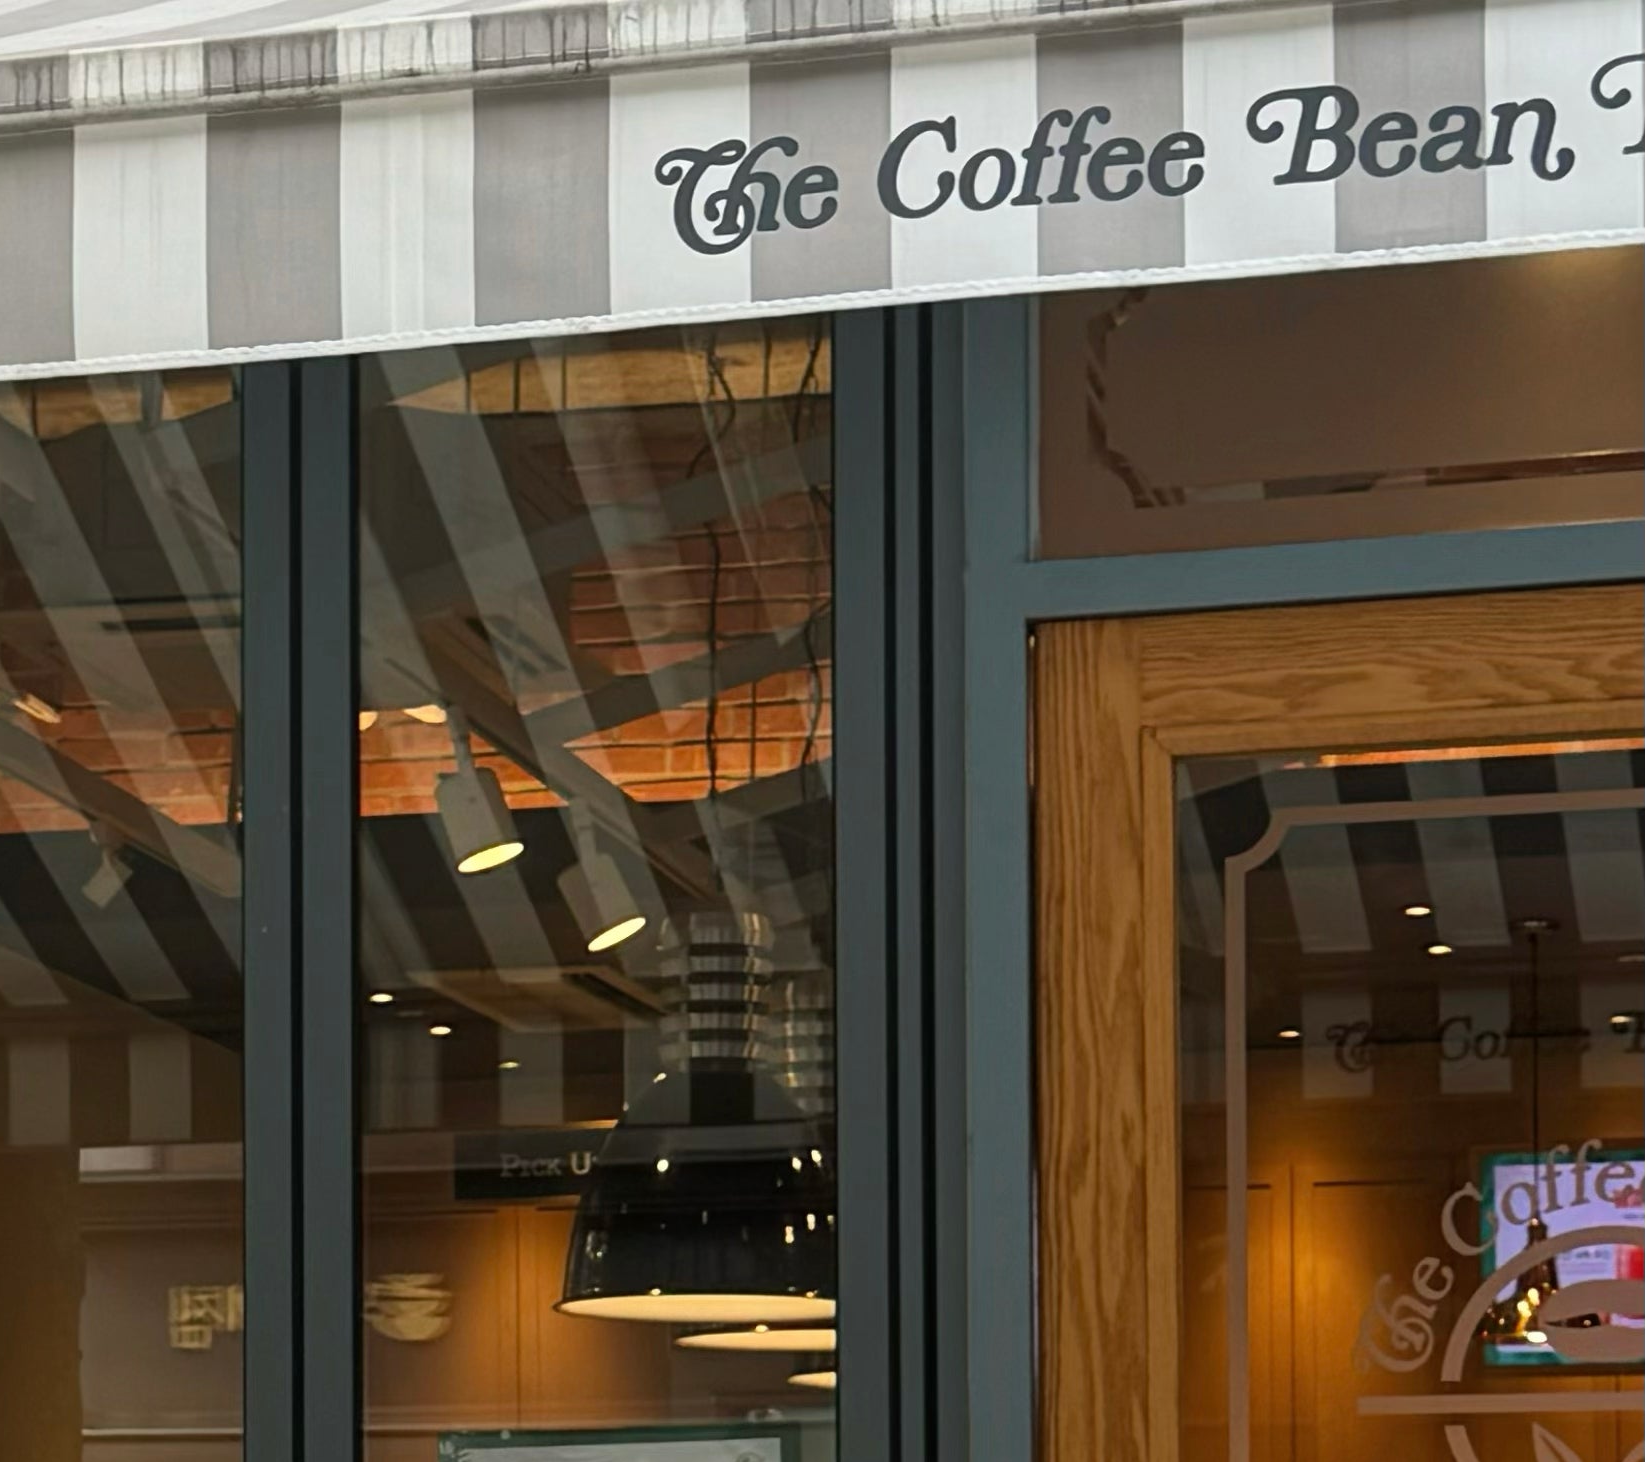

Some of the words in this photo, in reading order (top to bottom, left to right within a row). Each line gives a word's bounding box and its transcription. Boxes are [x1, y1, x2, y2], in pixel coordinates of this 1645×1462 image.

[655, 136, 839, 255] The
[876, 106, 1206, 220] Coffee
[1246, 84, 1575, 185] Bean
[569, 1151, 598, 1176] U
[1351, 1256, 1454, 1374] The
[1441, 1138, 1645, 1256] Coffe
